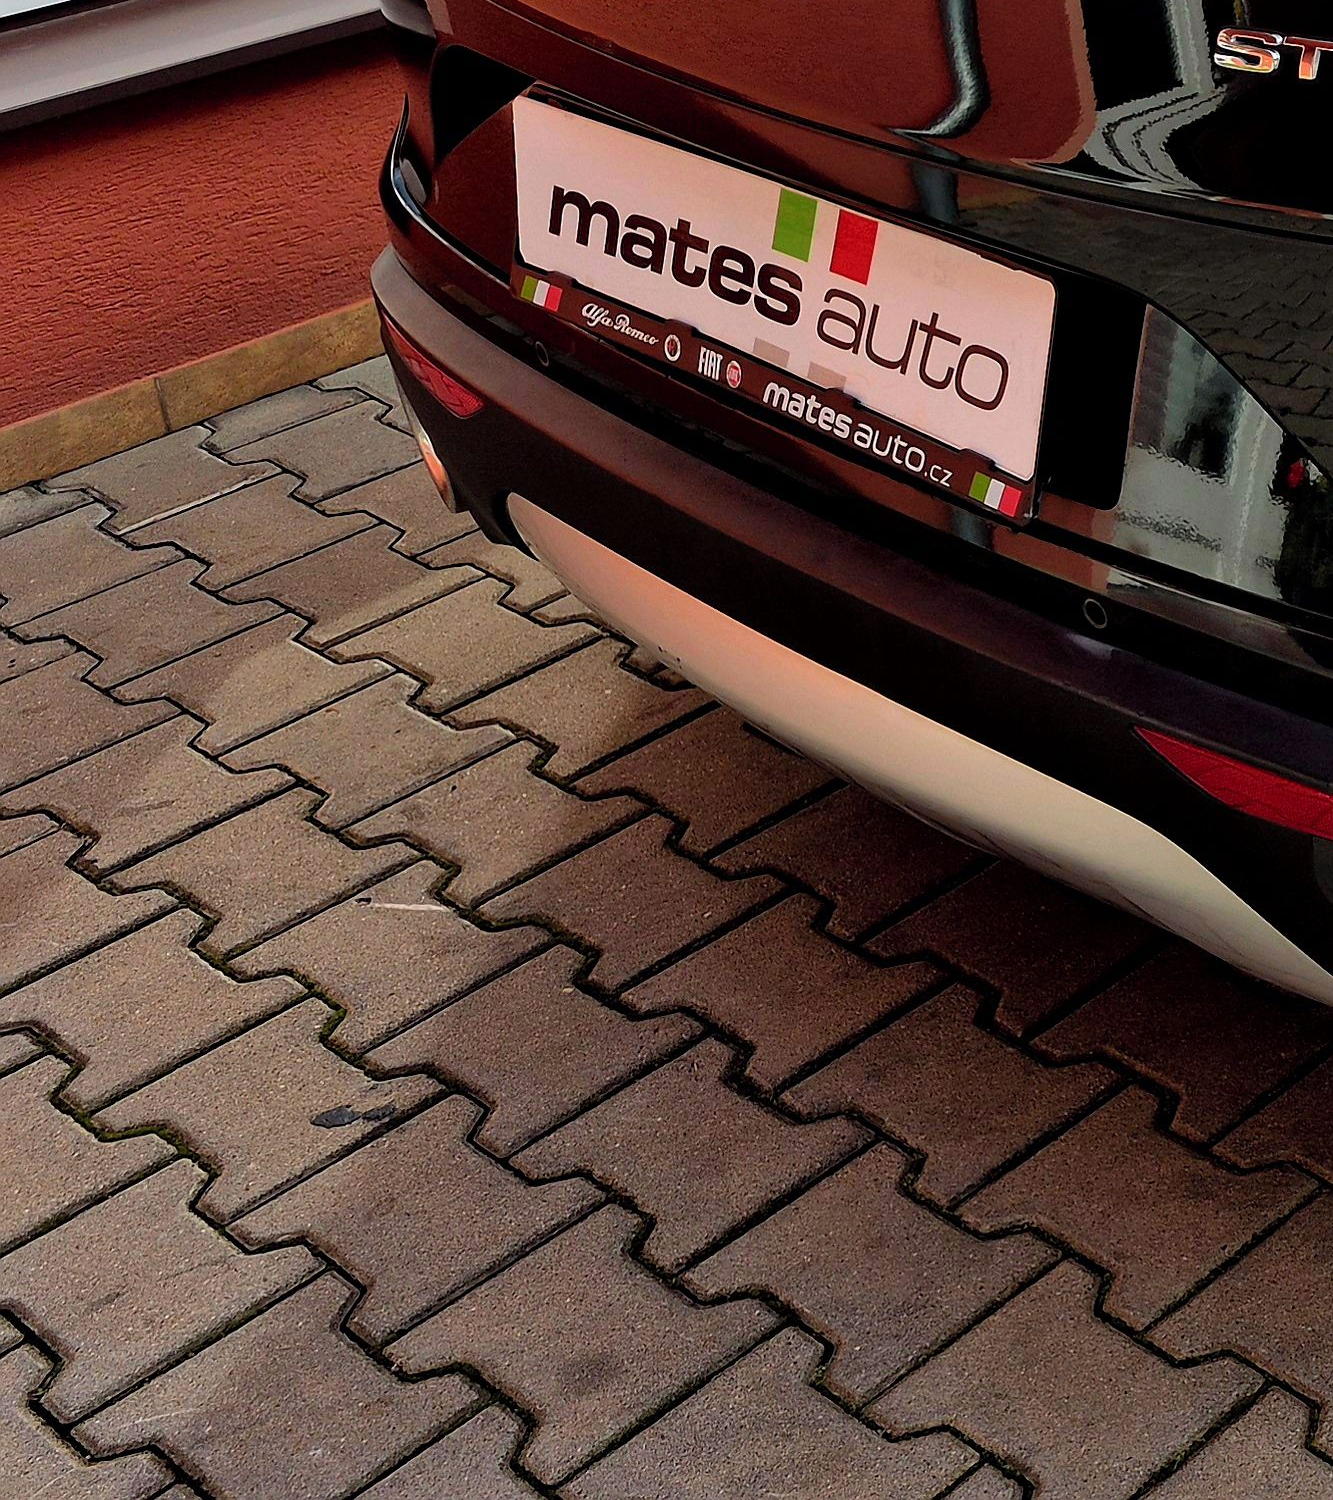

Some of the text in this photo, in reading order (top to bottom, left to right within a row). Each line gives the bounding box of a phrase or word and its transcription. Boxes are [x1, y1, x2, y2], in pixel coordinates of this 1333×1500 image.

[548, 184, 1010, 412] mates auto
[582, 303, 614, 327] Alfa
[613, 313, 660, 345] Romeo
[698, 346, 723, 381] FIAT
